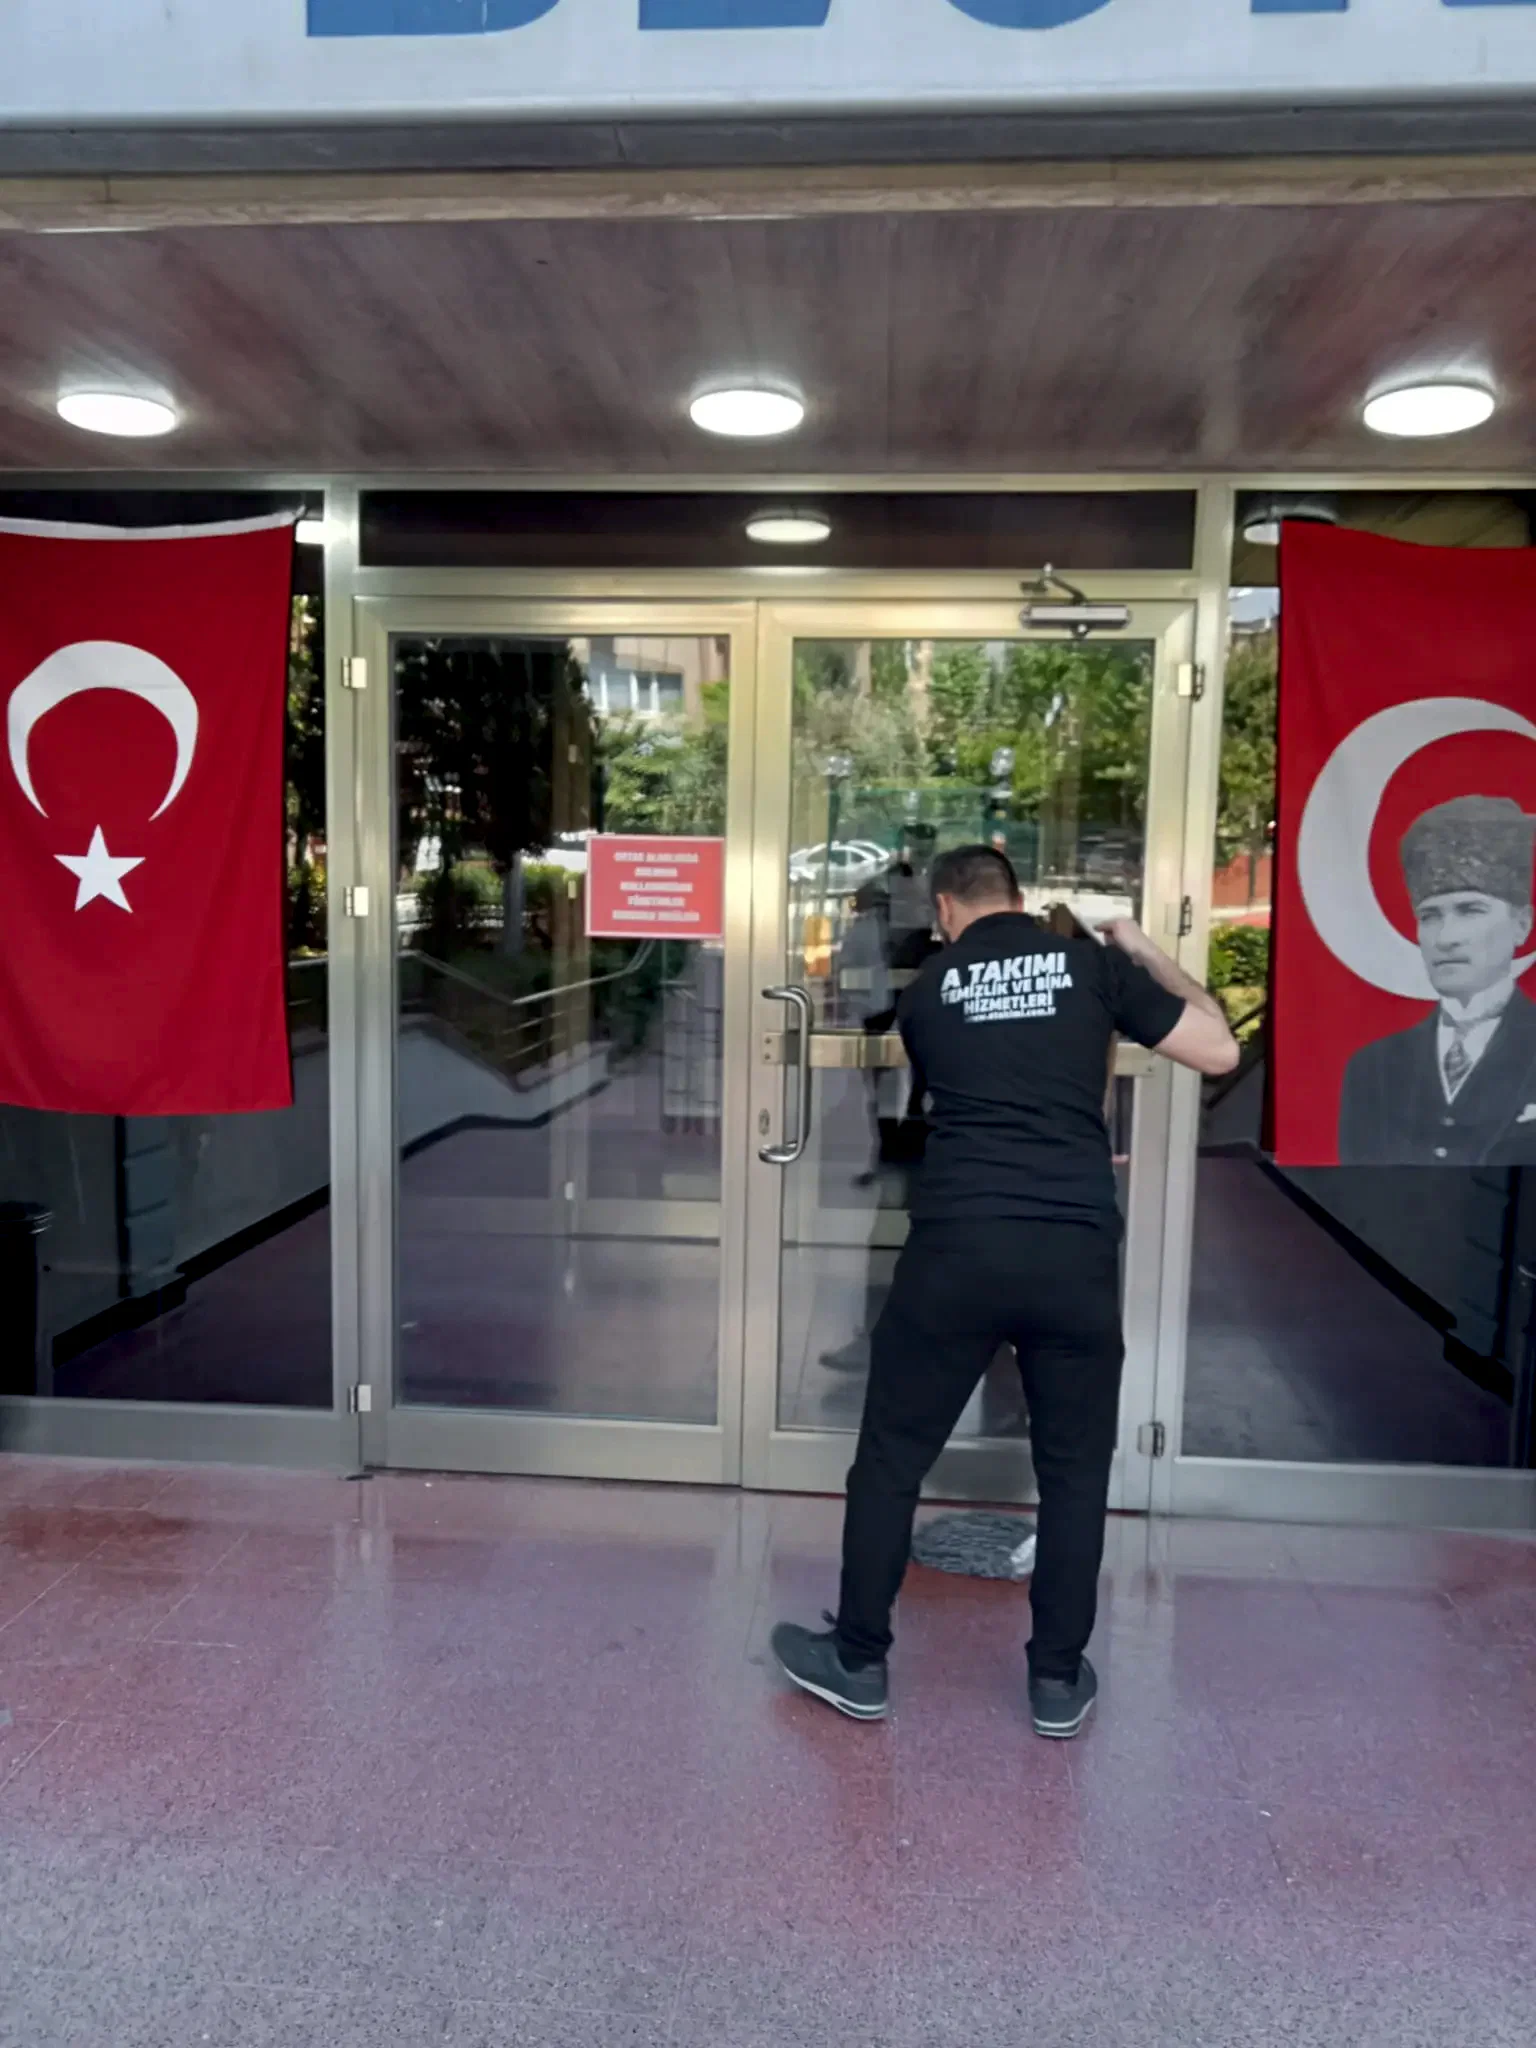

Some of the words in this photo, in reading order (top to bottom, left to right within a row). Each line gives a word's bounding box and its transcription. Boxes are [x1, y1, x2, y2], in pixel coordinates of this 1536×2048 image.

[941, 967, 961, 991] A
[968, 952, 1066, 984] TAKIMI
[940, 980, 1008, 1005] TEMİZLİK
[1012, 978, 1032, 994] VE
[1036, 973, 1073, 991] BİNA
[964, 989, 1053, 1015] HİZMETLERİ
